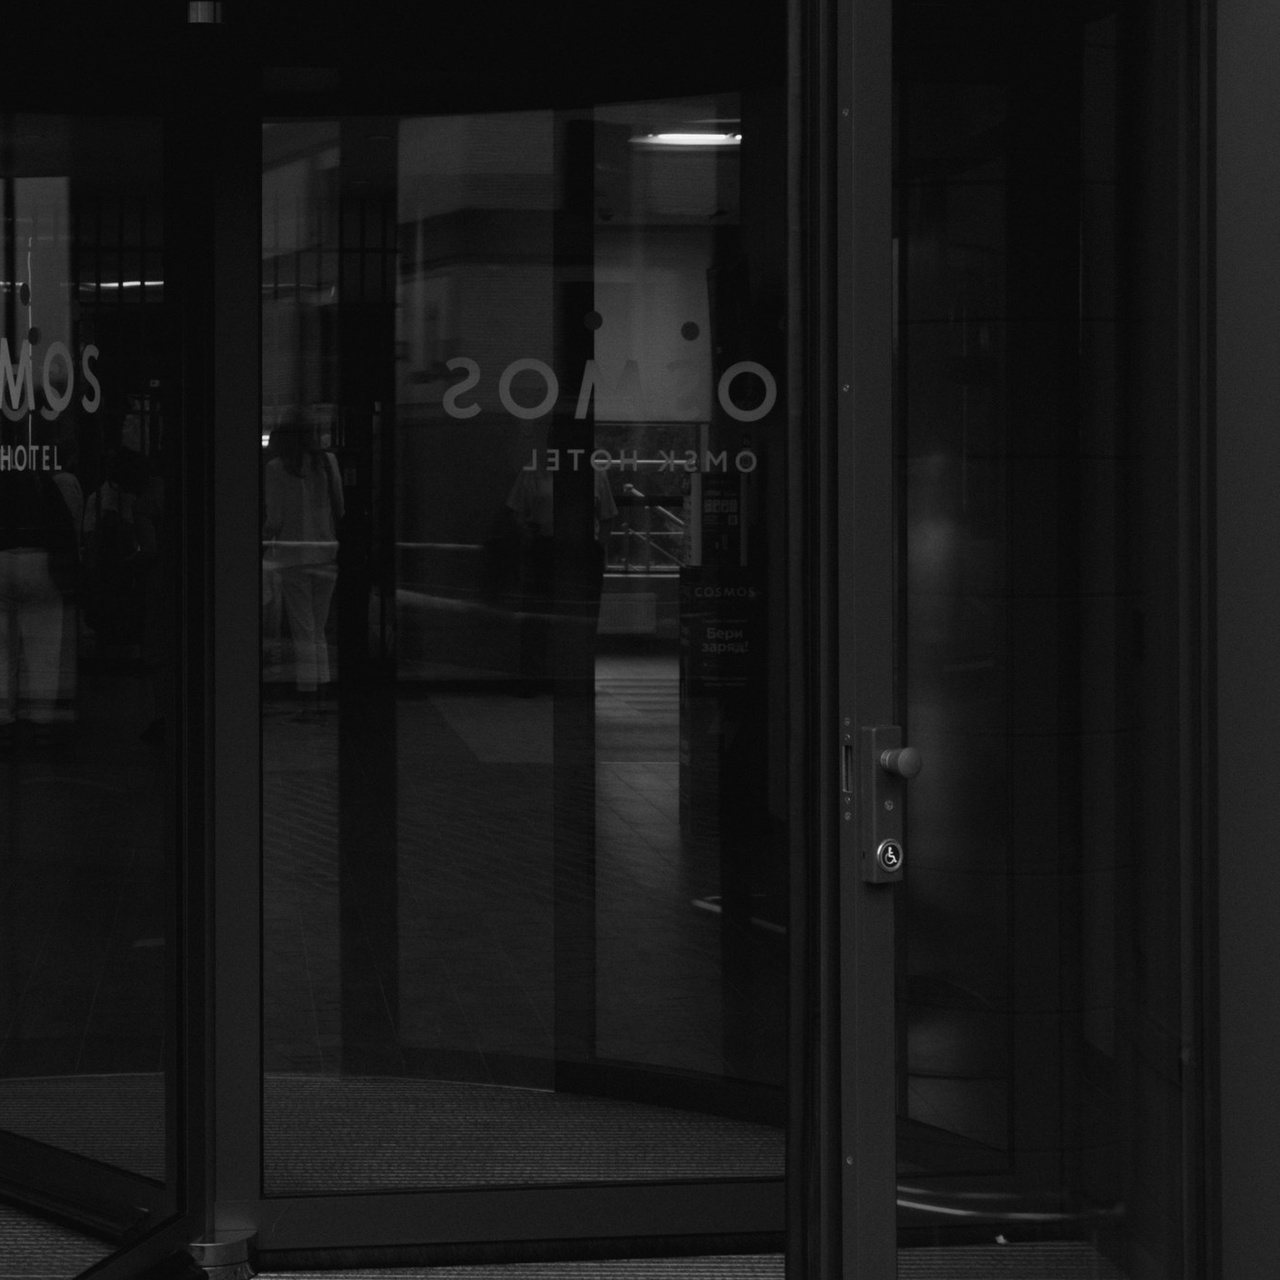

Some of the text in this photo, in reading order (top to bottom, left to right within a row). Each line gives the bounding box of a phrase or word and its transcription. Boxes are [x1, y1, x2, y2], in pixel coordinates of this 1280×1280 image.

[0, 444, 62, 471] HOTEL
[694, 586, 756, 598] COSMOS
[706, 627, 743, 641] Бери
